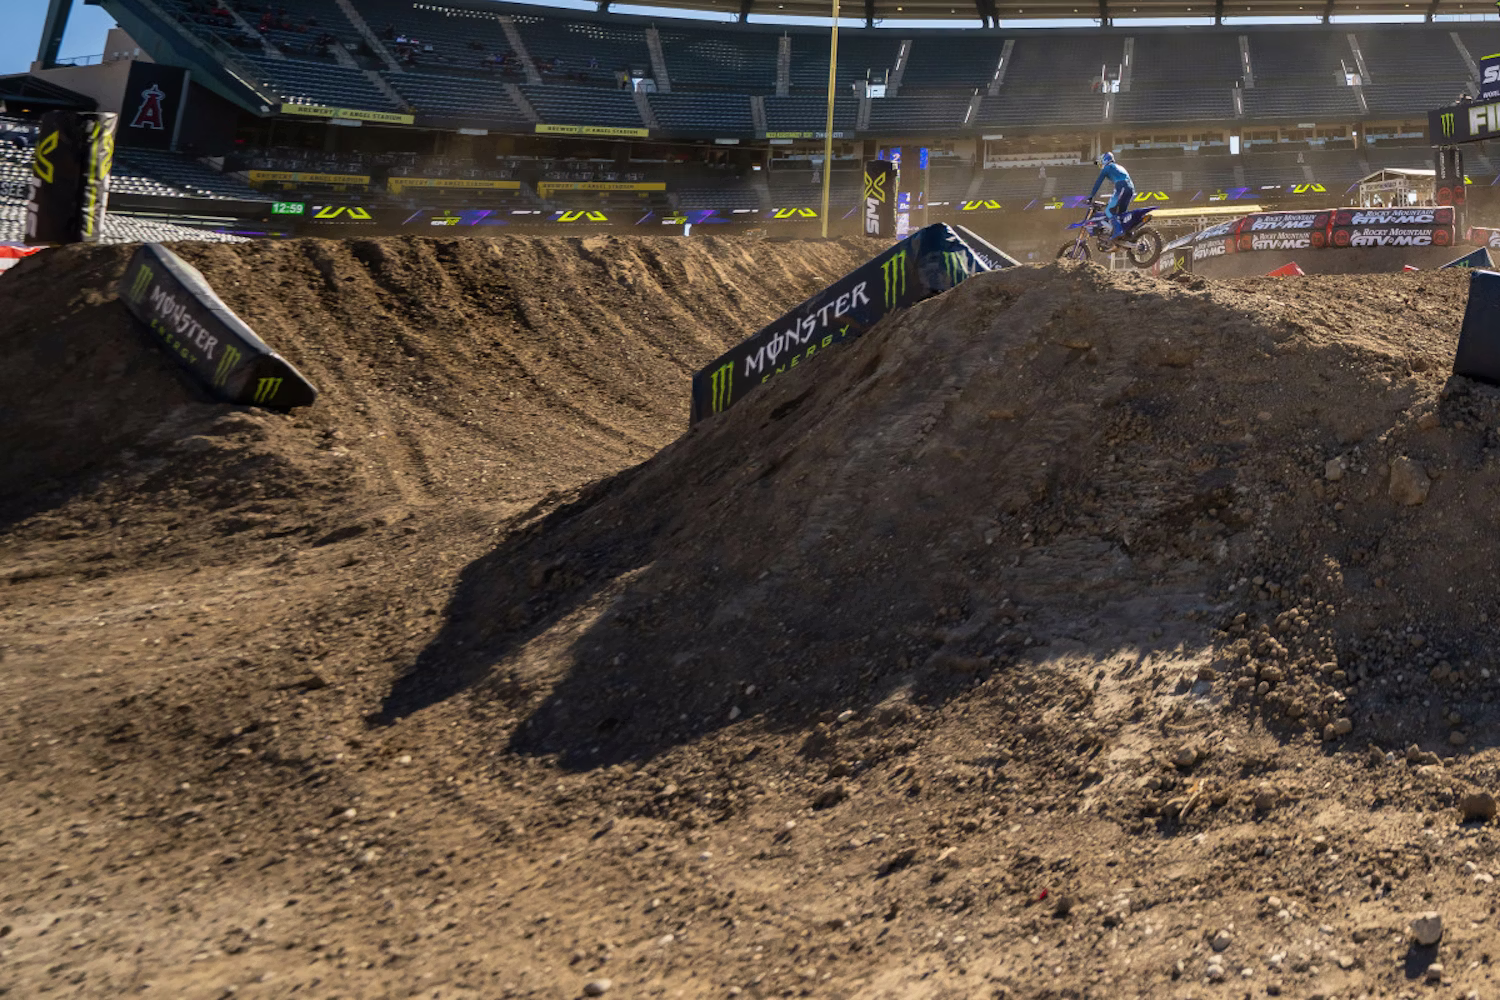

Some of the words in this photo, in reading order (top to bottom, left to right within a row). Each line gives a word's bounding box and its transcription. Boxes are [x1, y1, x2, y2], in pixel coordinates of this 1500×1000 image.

[273, 203, 304, 213] 12:59
[1260, 232, 1277, 240] ROCKY
[1389, 228, 1432, 236] MOUNTAIN
[150, 285, 219, 360] MONSTER
[151, 318, 198, 364] ENERGY
[743, 280, 871, 377] MONSTER
[760, 324, 850, 384] ENERGY
